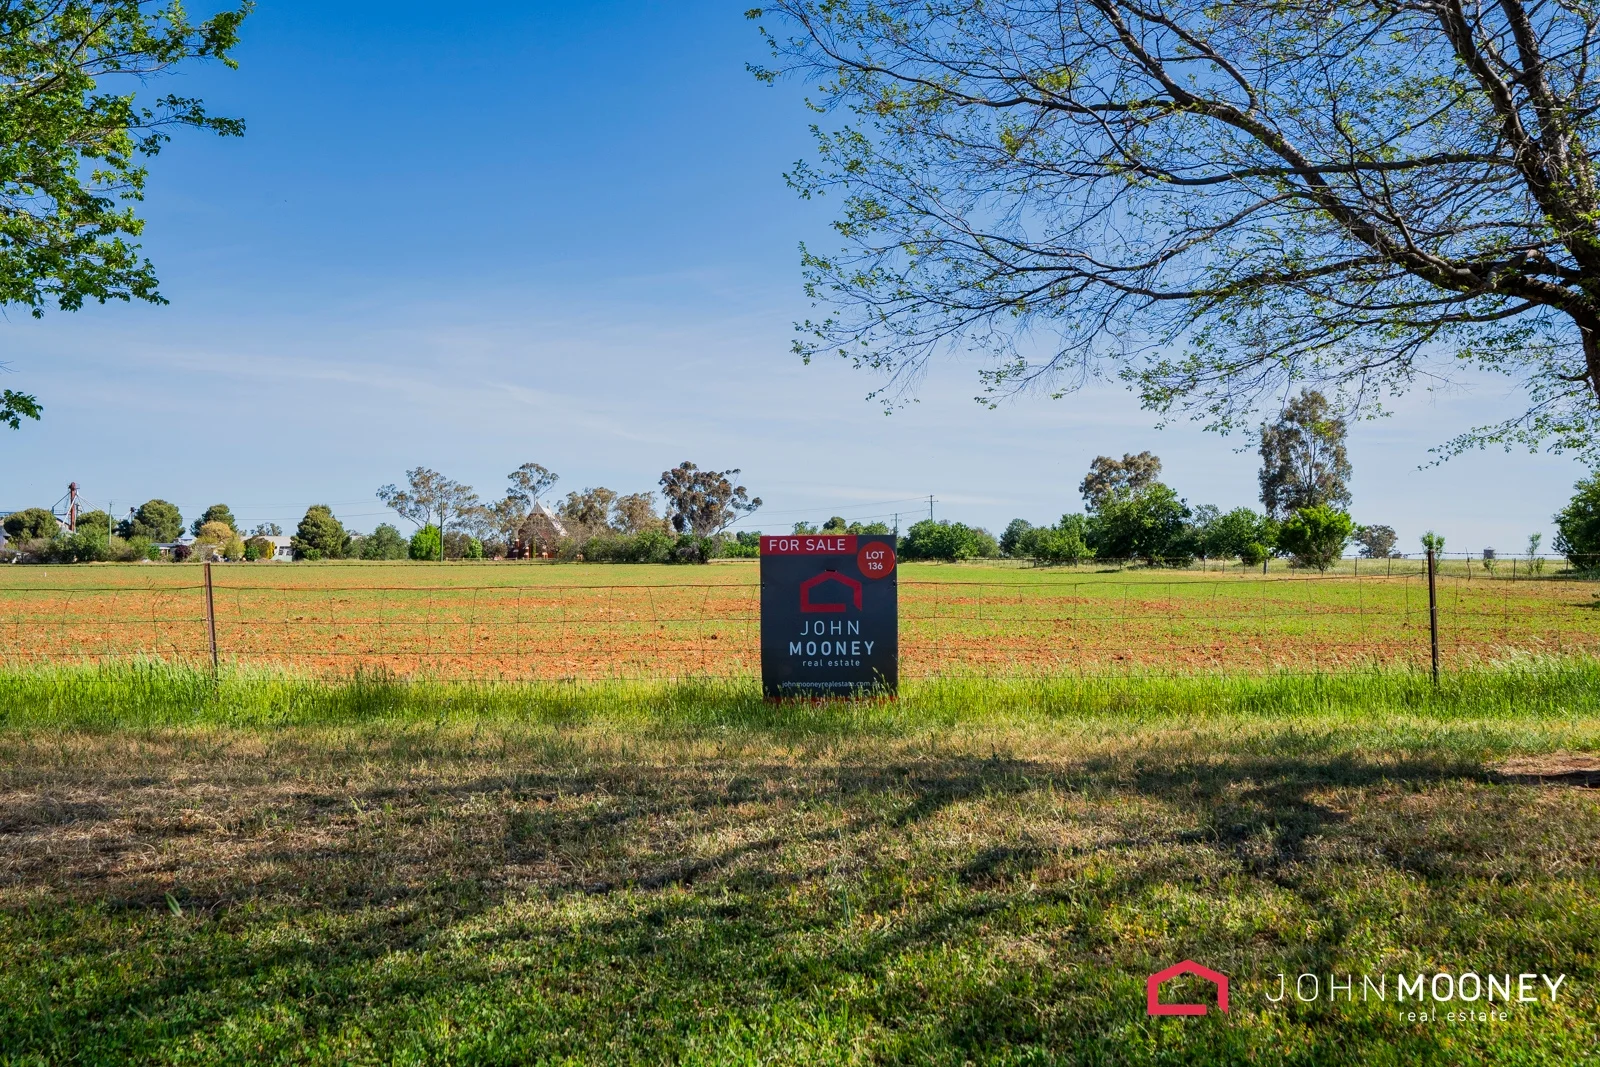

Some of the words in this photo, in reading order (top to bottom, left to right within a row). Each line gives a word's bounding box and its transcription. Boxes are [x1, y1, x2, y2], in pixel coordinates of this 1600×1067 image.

[769, 539, 800, 551] FOR
[806, 539, 846, 551] SALE
[866, 551, 885, 560] LOT
[868, 562, 883, 570] 136
[800, 620, 860, 636] JOHN
[789, 641, 875, 656] MOONEY
[802, 659, 823, 667] real
[827, 659, 861, 667] estate
[781, 680, 881, 688] johnmooneyrealestate.com.
